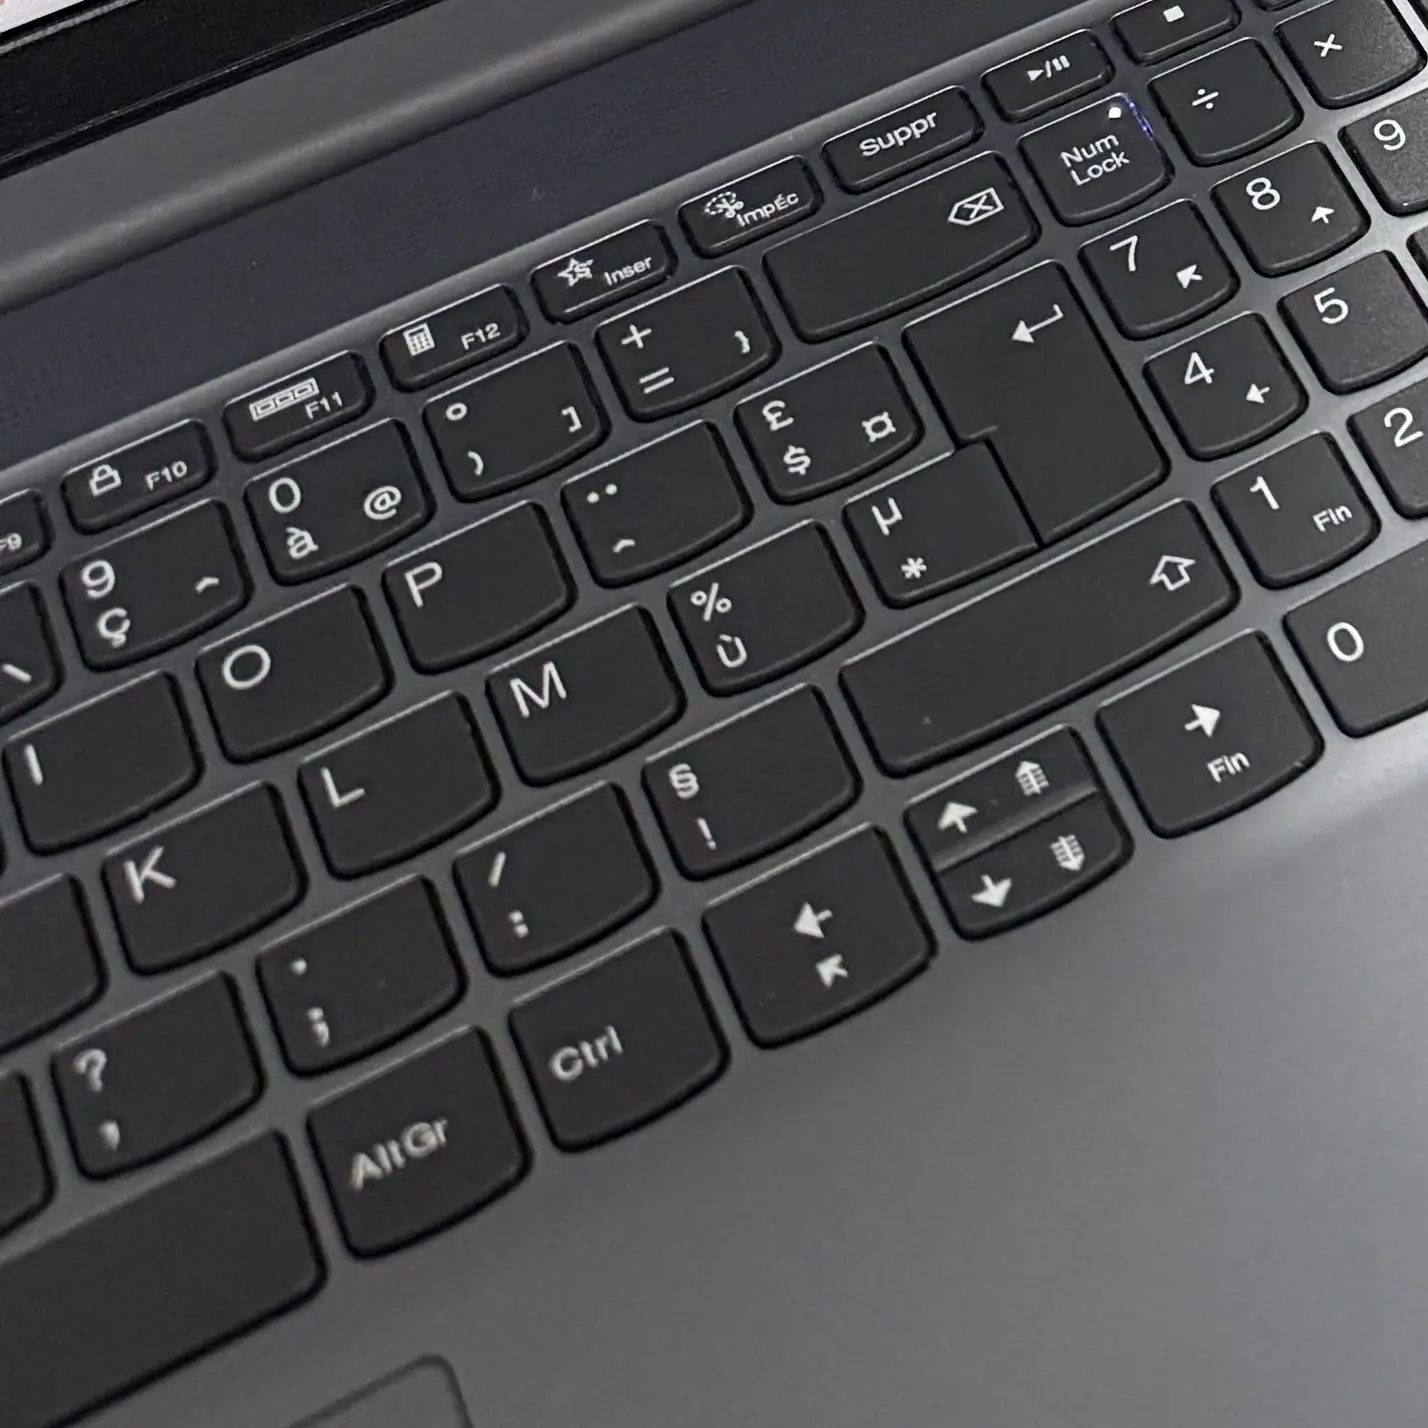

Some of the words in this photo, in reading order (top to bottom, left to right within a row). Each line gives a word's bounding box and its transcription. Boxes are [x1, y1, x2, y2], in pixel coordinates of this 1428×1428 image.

[859, 110, 938, 158] Suppr
[1060, 132, 1119, 167] Num
[1373, 118, 1407, 152] 9
[1070, 150, 1131, 187] Lock
[736, 189, 800, 228] ImpÉc
[603, 255, 654, 286] Inser
[460, 322, 501, 351] F12
[305, 391, 344, 420] F11
[145, 460, 188, 490] F10
[1250, 475, 1281, 511] 1
[1312, 501, 1353, 533] Fin
[1326, 621, 1364, 662] 0
[508, 660, 568, 718] M
[1207, 749, 1251, 783] Fin
[548, 1026, 624, 1082] Ctrl
[349, 1117, 449, 1191] AltGr
